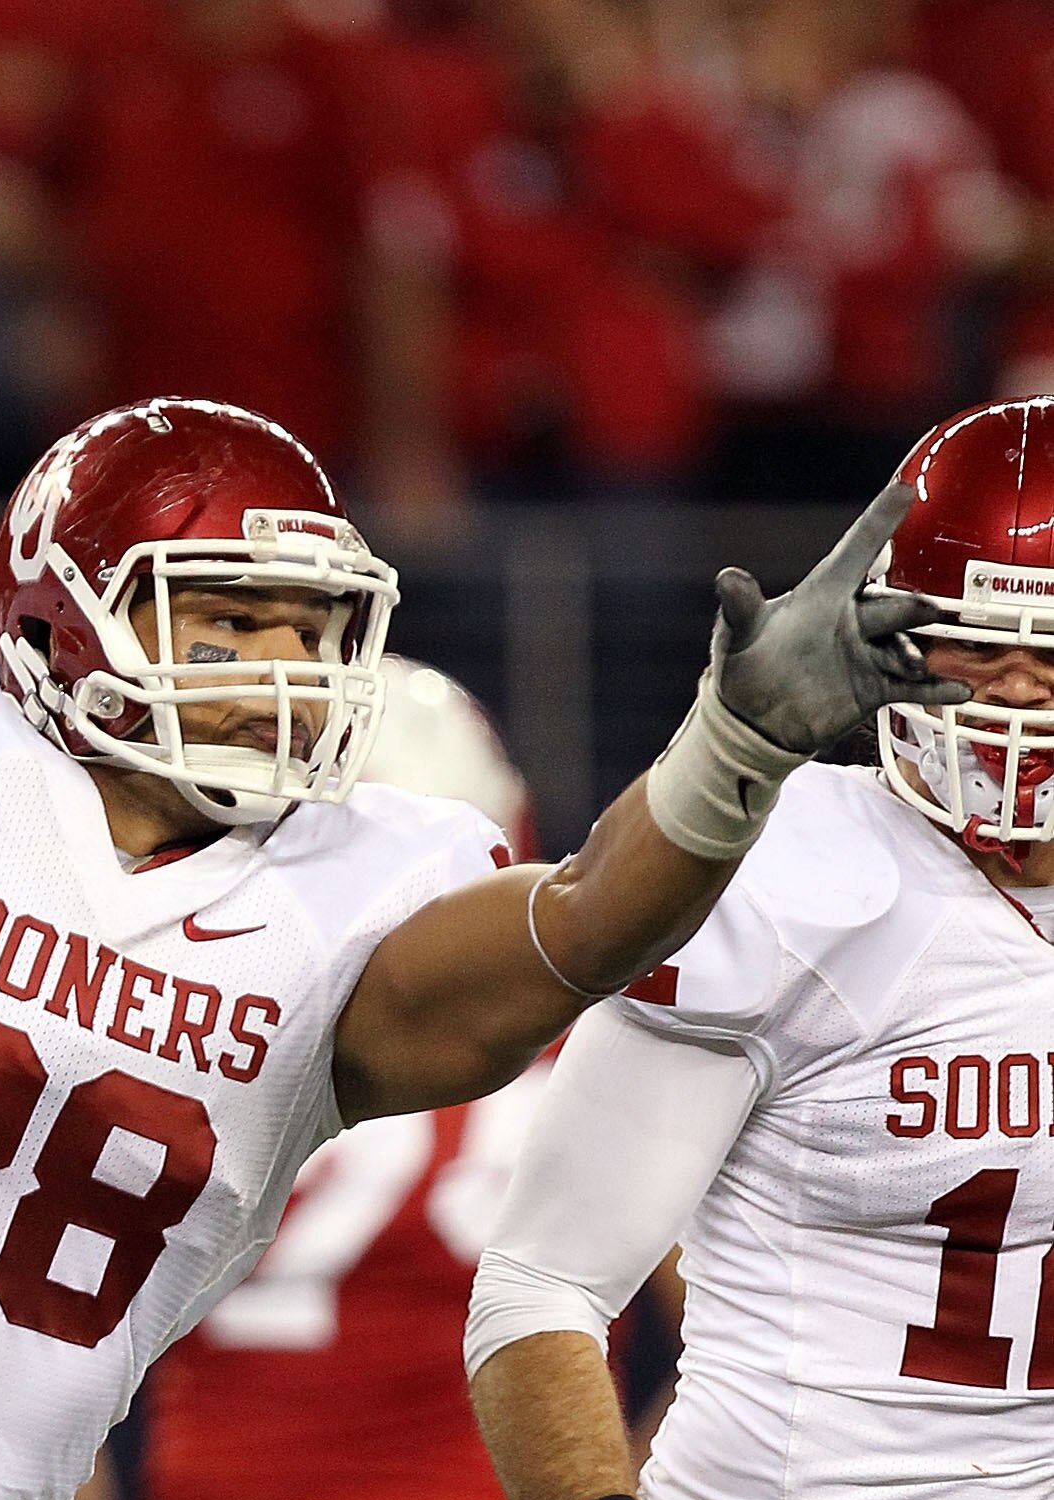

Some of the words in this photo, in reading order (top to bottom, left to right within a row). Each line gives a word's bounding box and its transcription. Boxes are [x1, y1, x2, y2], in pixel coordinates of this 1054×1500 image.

[277, 519, 335, 541] OKLA
[886, 1053, 1054, 1140] SOO
[899, 1167, 1054, 1391] 1
